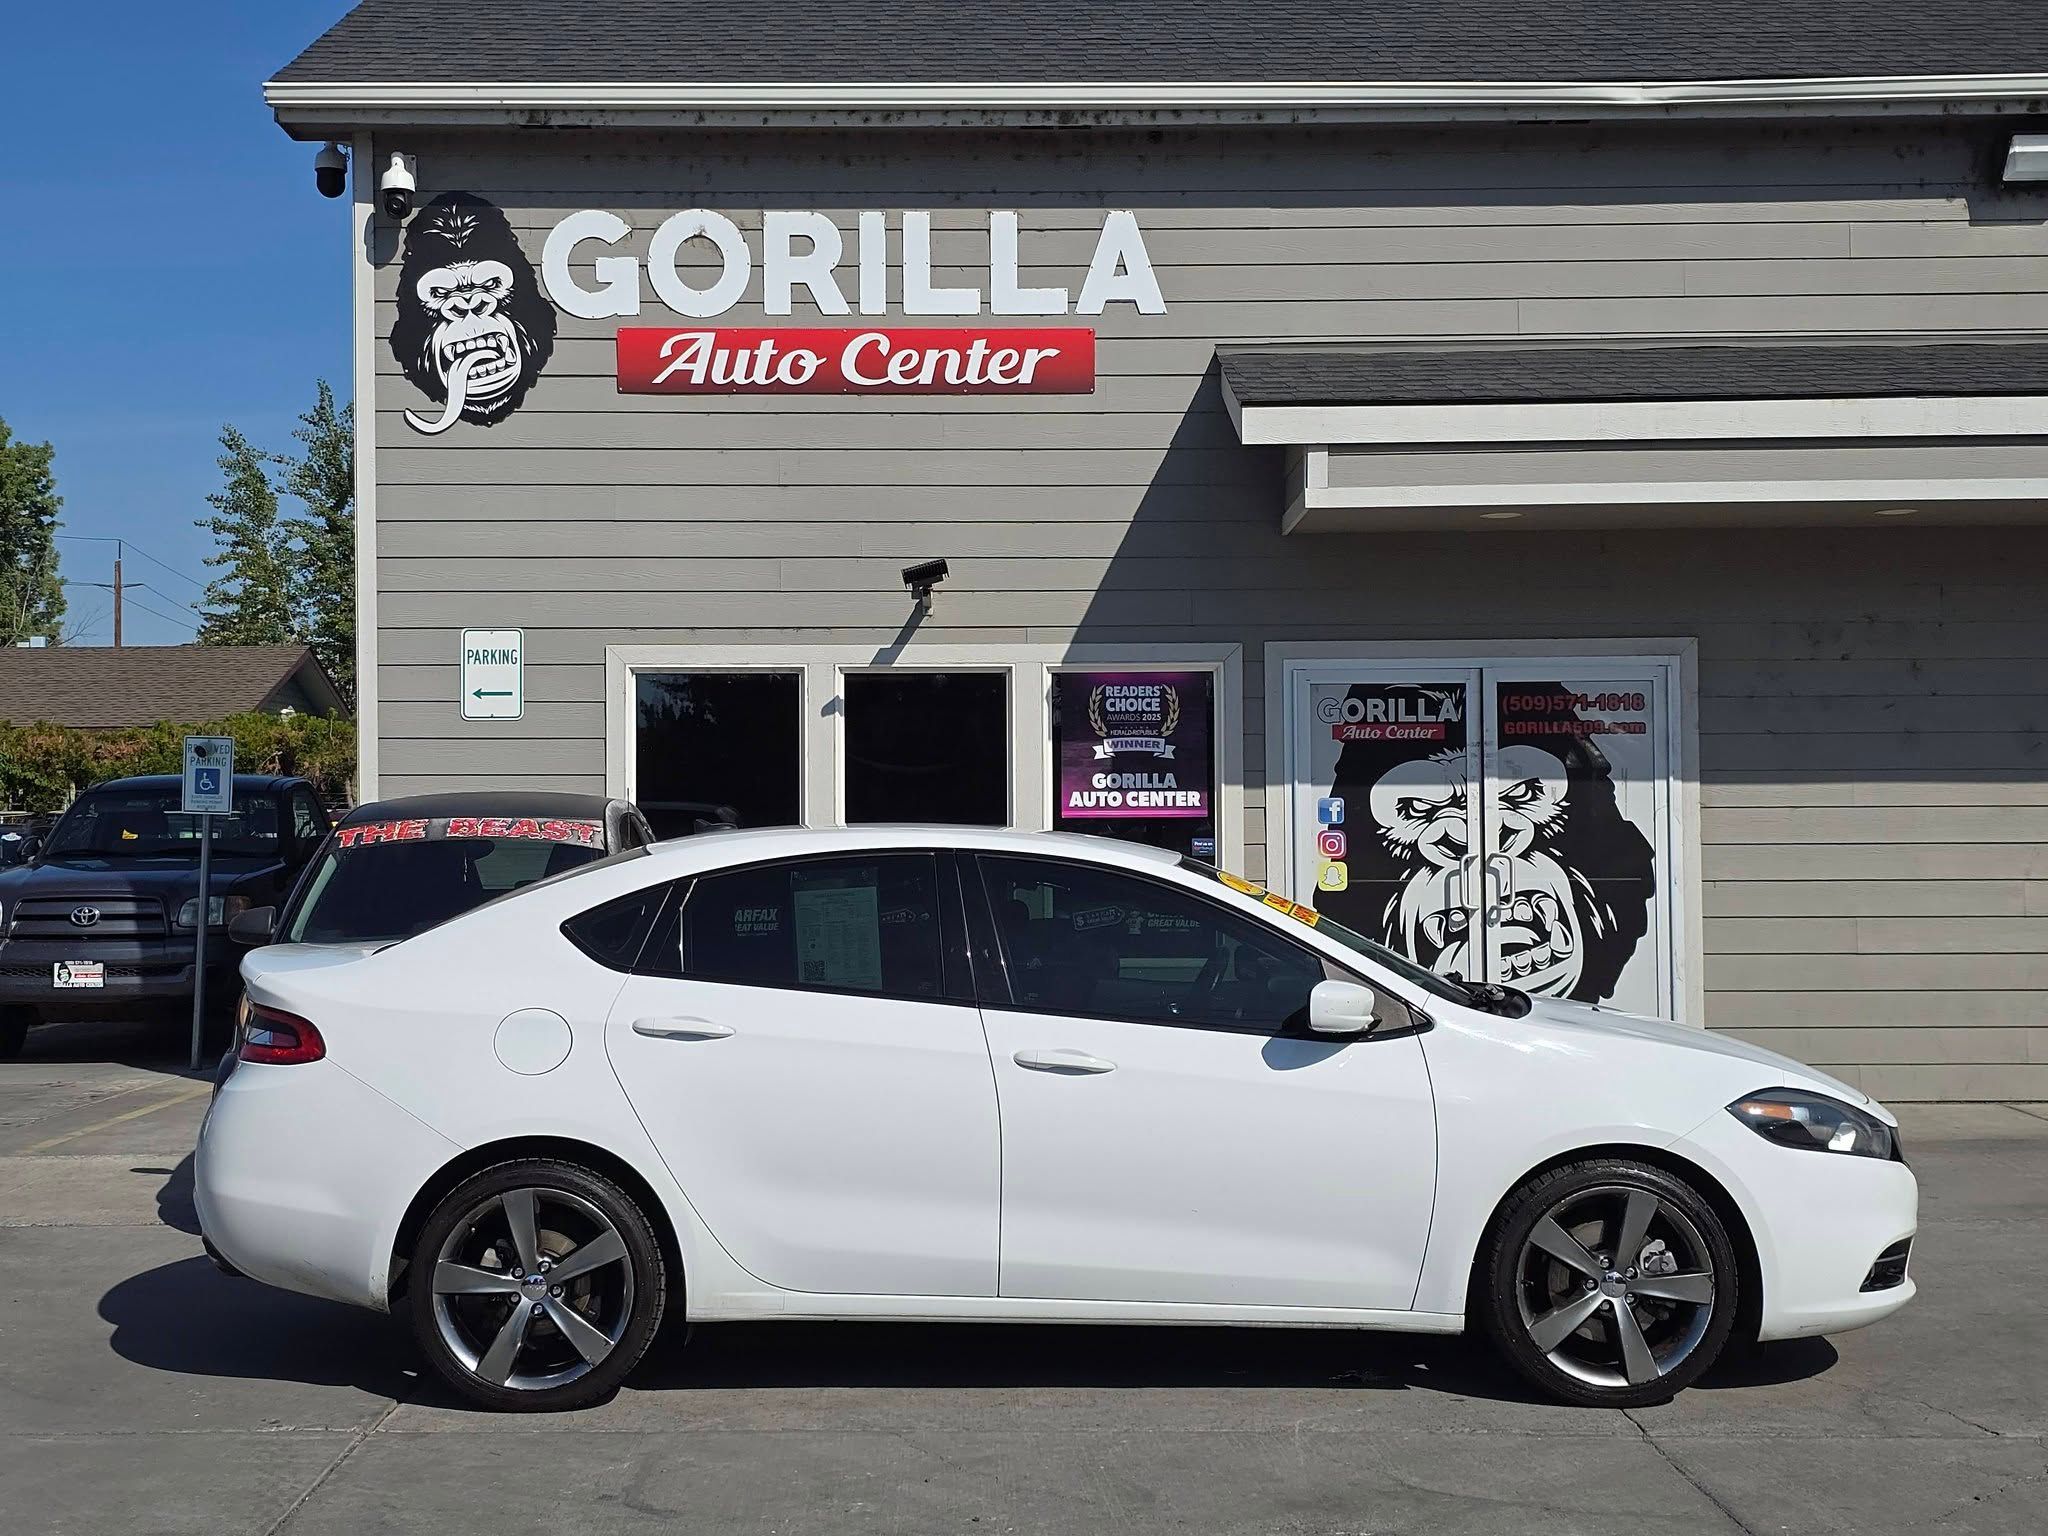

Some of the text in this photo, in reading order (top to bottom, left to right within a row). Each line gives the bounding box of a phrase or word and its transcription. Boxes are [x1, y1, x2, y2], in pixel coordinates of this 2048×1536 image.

[540, 209, 1167, 318] GORILLA
[652, 332, 1062, 385] Auto Center
[467, 649, 518, 665] PARKING
[1105, 685, 1163, 697] READERS'
[1105, 698, 1161, 712] CHOICE
[1316, 697, 1459, 724] GORILLA
[1502, 692, 1646, 715] (509)571-1818
[1106, 713, 1162, 721] AWARDS 2025
[1341, 725, 1437, 739] Auto Center
[1503, 719, 1647, 735] GORILLA509.com
[1107, 740, 1161, 749] WINNER
[190, 757, 227, 767] PARKING
[1091, 773, 1177, 789] GORILLA
[1069, 791, 1201, 807] AUTO CENTER
[335, 817, 603, 848] THE BEAST
[734, 908, 778, 922] ARFAX
[753, 922, 779, 931] VALUE
